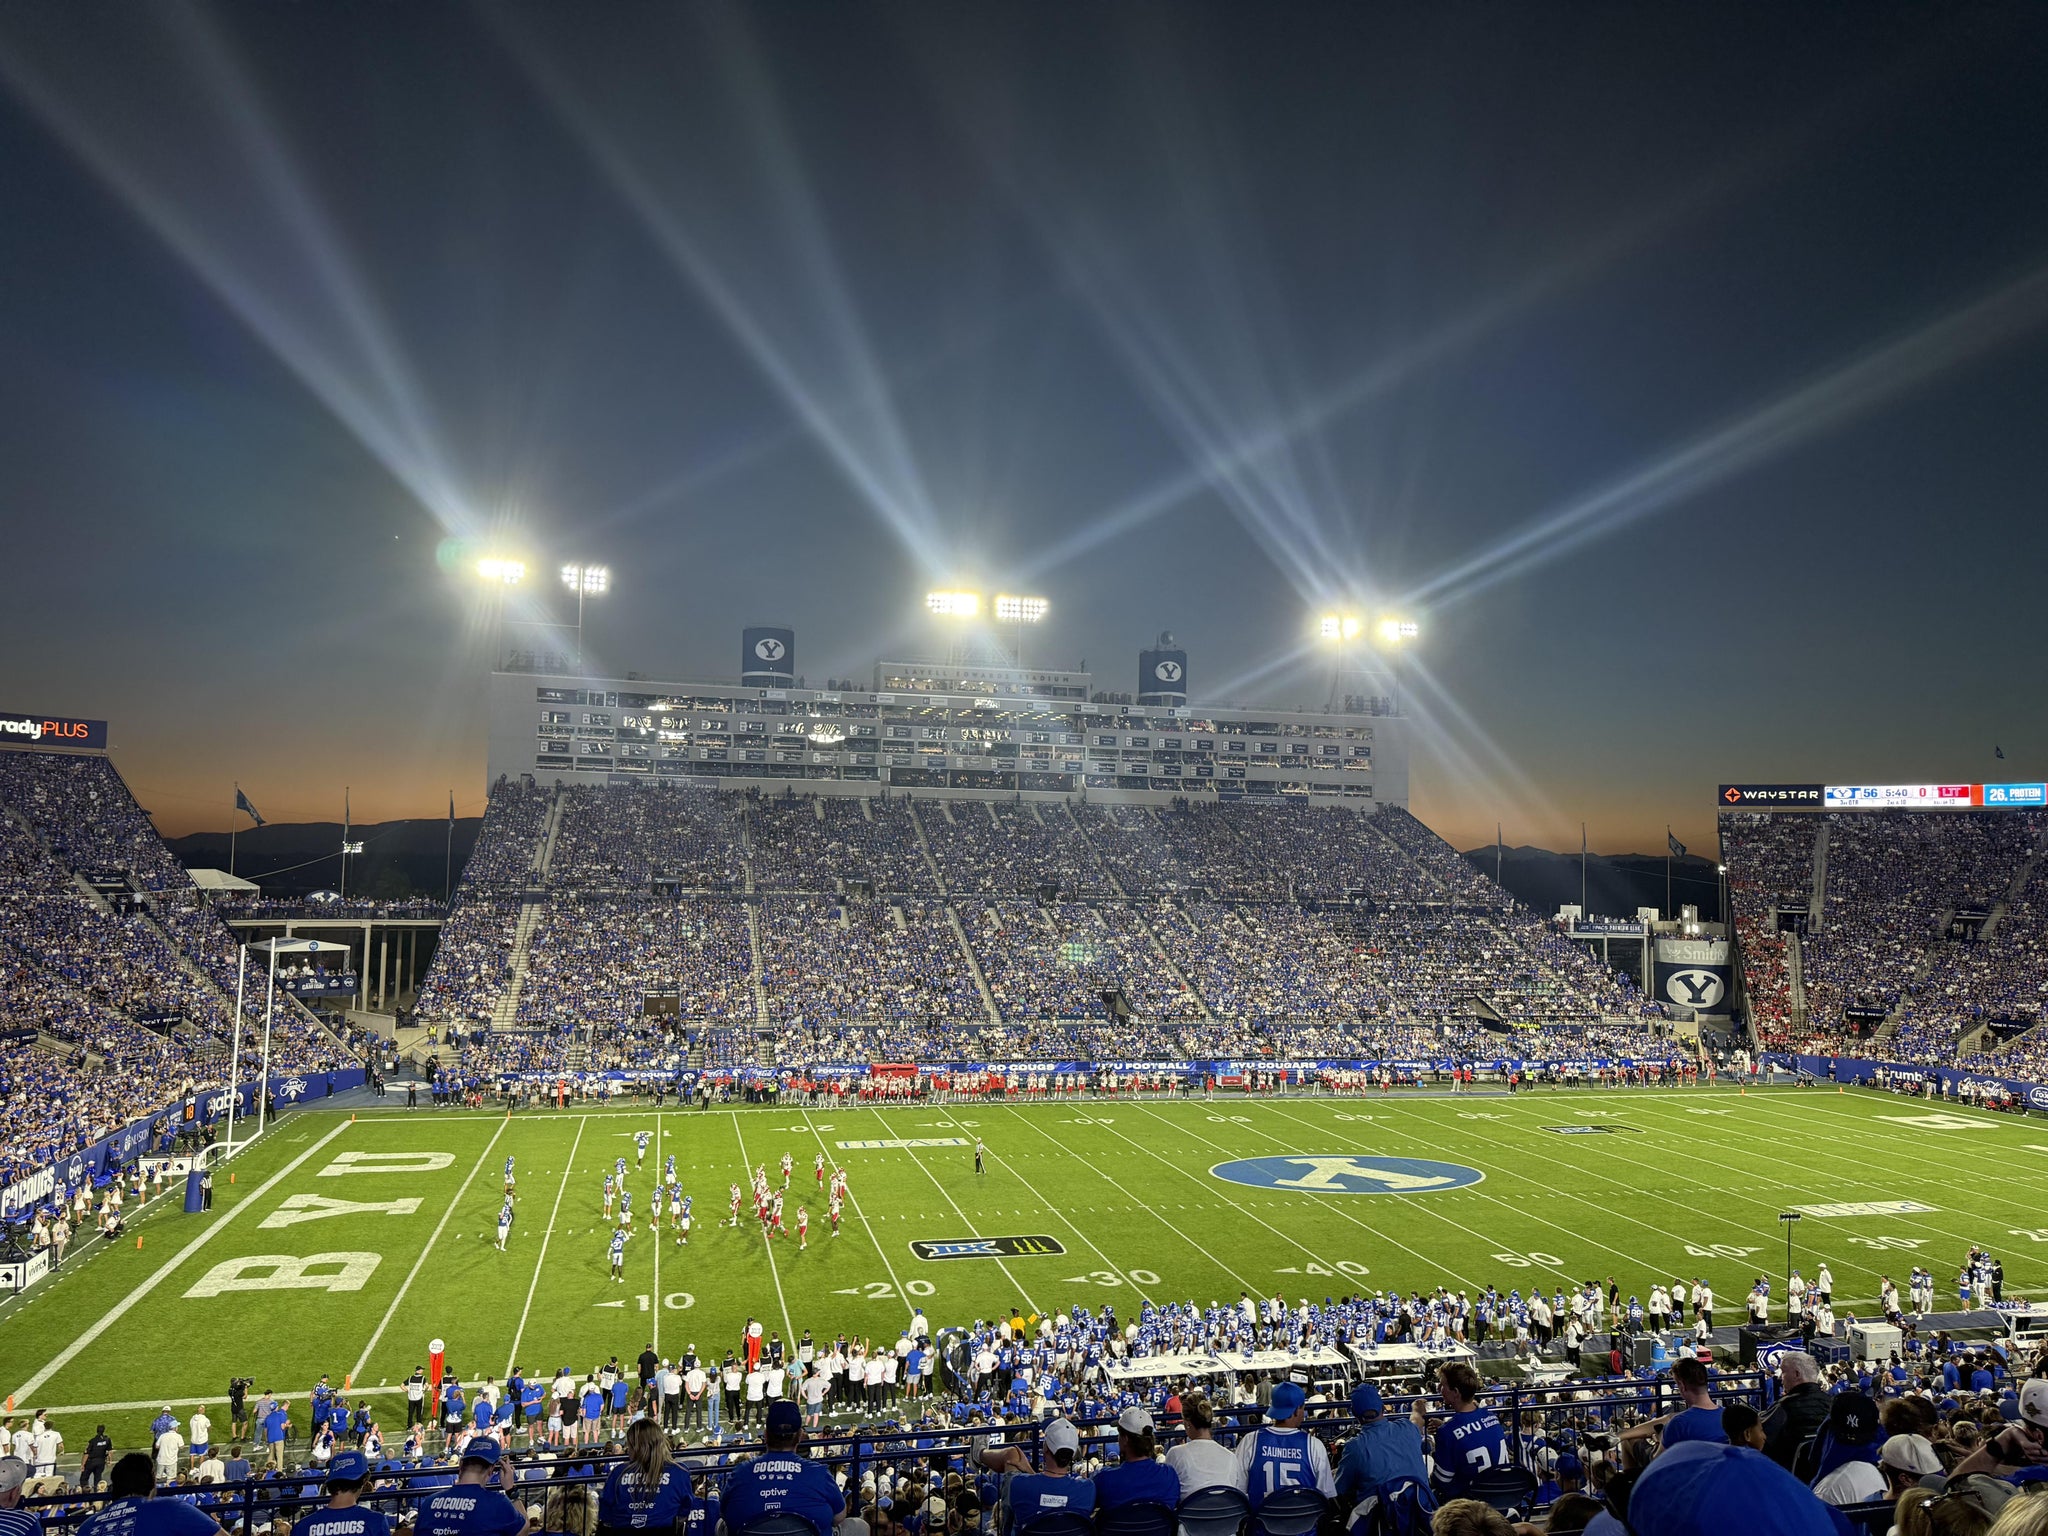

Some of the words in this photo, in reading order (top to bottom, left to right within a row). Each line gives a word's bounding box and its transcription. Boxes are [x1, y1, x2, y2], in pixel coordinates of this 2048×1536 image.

[761, 640, 781, 658] Y
[1160, 663, 1178, 680] Y
[1743, 790, 1819, 799] WAYSTAR
[1863, 788, 1878, 798] 56
[1885, 788, 1908, 797] 5:40
[1919, 788, 1926, 797] 0
[2009, 787, 2041, 798] PROTEIN
[1675, 974, 1717, 1003] Y
[1125, 1062, 1190, 1070] FOOTBALL
[1889, 1069, 1923, 1083] rumb
[186, 1105, 195, 1119] 18
[18, 1165, 55, 1209] COUGS
[1847, 1236, 1919, 1250] 30
[1683, 1244, 1749, 1258] 40
[1491, 1252, 1564, 1268] 50
[1303, 1261, 1370, 1277] 40
[1086, 1269, 1162, 1287] 30
[864, 1280, 936, 1299] 20
[635, 1292, 696, 1310] 10
[1356, 1327, 1367, 1337] 53
[1058, 1339, 1069, 1349] 73
[1020, 1355, 1032, 1364] 58
[1040, 1379, 1051, 1390] 66
[1453, 1421, 1482, 1440] BYU
[1262, 1445, 1302, 1459] SAUNDERS
[753, 1461, 767, 1473] GO
[767, 1460, 801, 1473] COUGS
[621, 1473, 635, 1486] GO
[1263, 1461, 1301, 1498] 15
[760, 1488, 787, 1498] aptive
[431, 1498, 443, 1510] GO
[443, 1498, 476, 1511] COUGS
[629, 1502, 655, 1511] aptive
[309, 1524, 325, 1536] GO
[325, 1521, 365, 1535] COUGS
